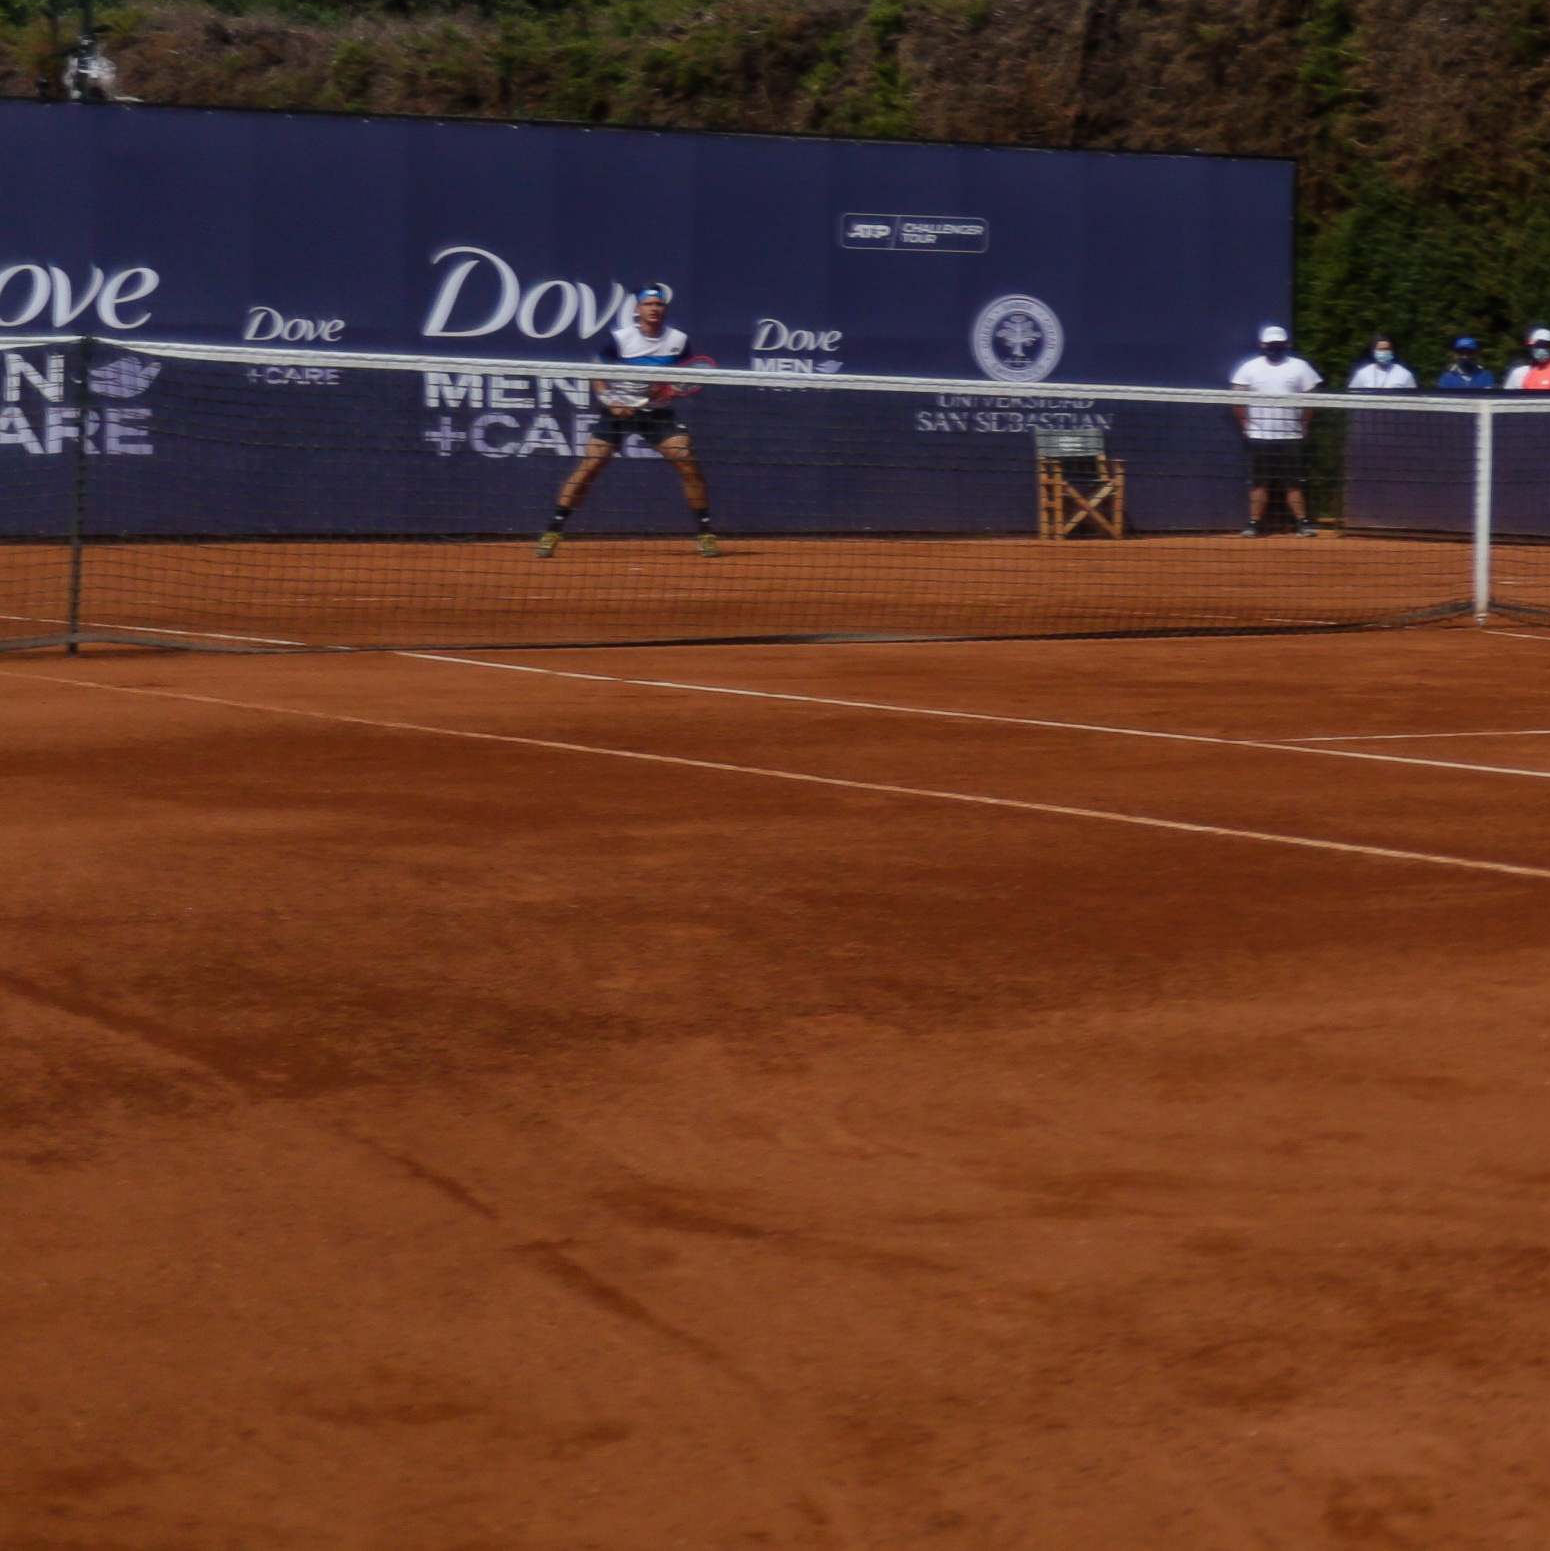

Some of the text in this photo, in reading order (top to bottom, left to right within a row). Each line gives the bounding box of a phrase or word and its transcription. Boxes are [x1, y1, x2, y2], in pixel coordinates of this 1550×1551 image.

[245, 307, 345, 341] Dove
[753, 319, 842, 351] Dove
[424, 372, 590, 409] MEN
[916, 412, 969, 431] SAN
